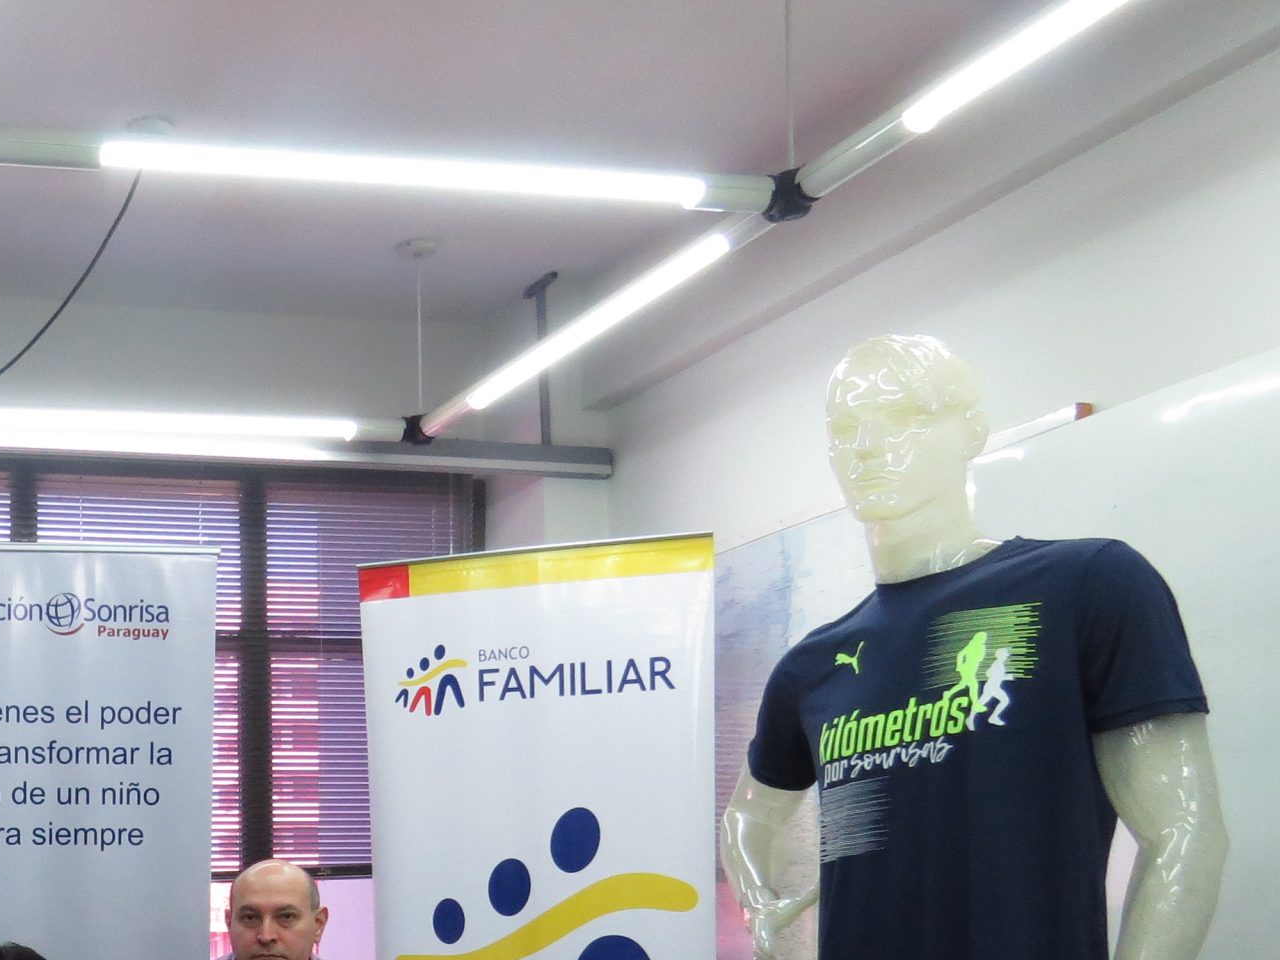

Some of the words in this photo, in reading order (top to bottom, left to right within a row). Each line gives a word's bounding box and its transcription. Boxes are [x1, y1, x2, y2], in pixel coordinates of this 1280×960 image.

[83, 598, 170, 623] Sonrisa
[97, 625, 169, 640] Paraguay
[478, 646, 530, 662] BANCO
[478, 656, 676, 702] FAMILIAR
[65, 700, 89, 724] el
[100, 701, 182, 730] poder
[818, 696, 970, 766] kilómetros
[149, 741, 172, 765] la
[824, 760, 848, 788] por
[11, 781, 45, 805] de
[57, 786, 90, 805] un
[101, 781, 160, 806] niño
[31, 822, 144, 851] siempre
